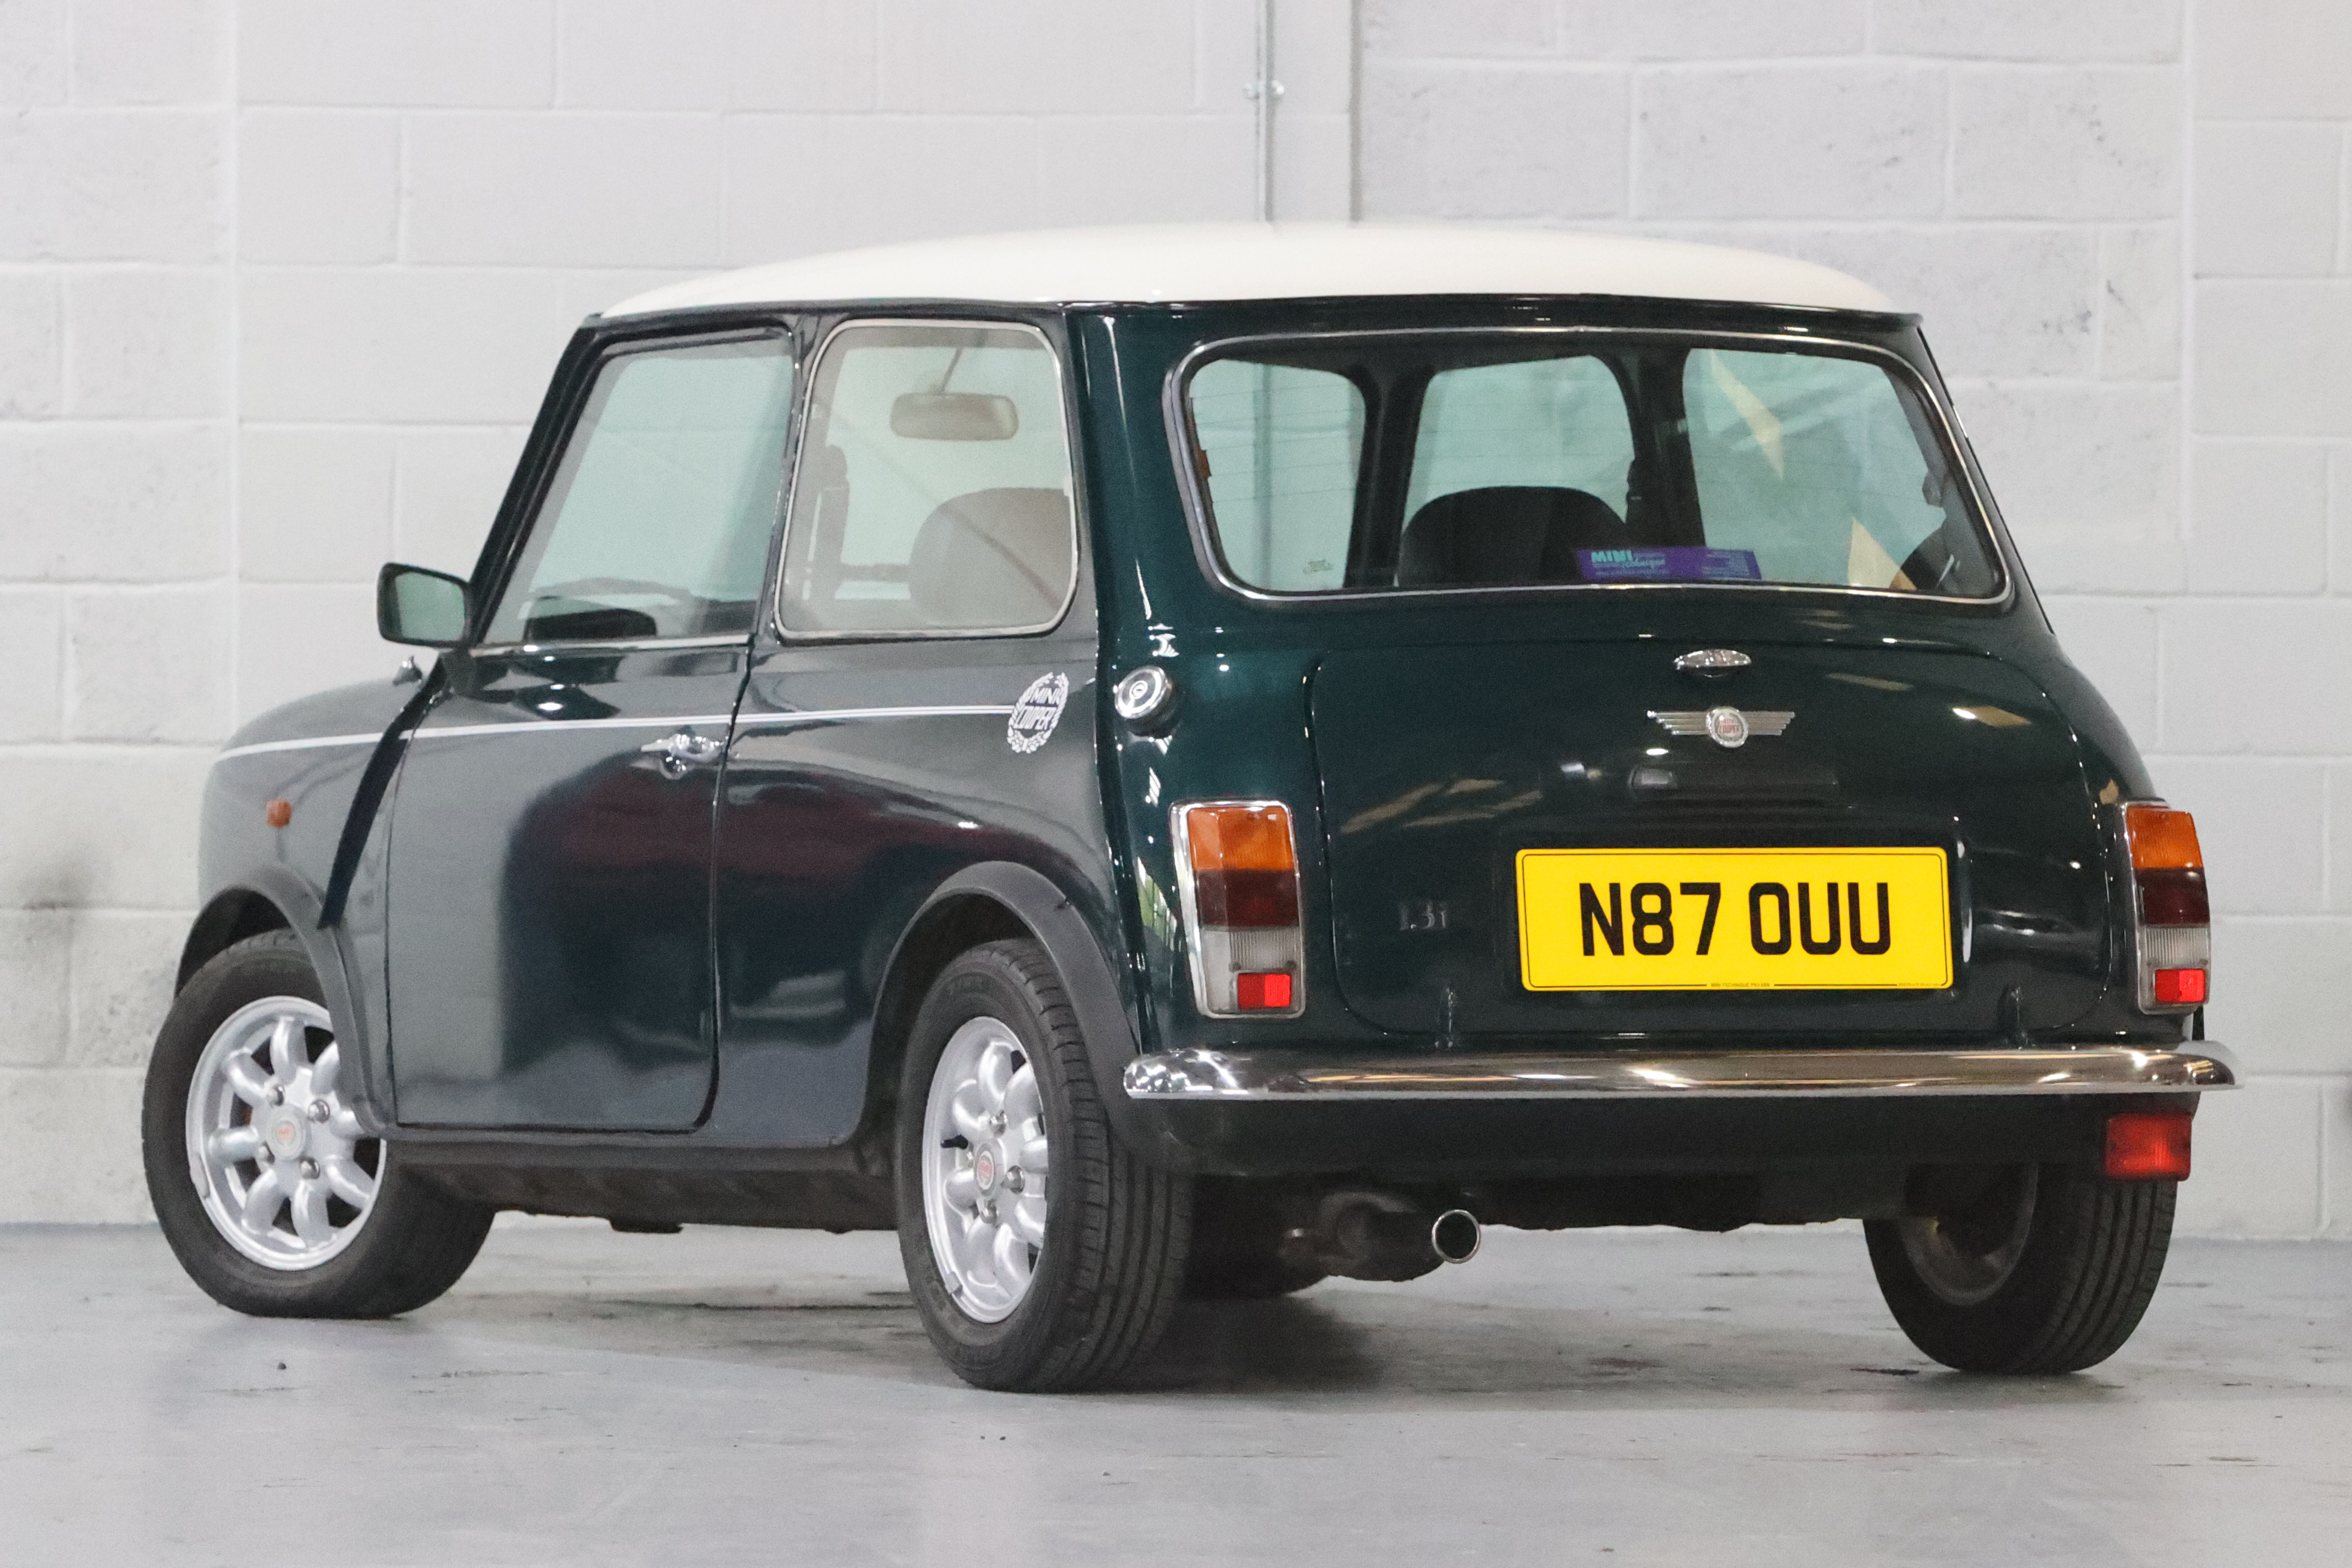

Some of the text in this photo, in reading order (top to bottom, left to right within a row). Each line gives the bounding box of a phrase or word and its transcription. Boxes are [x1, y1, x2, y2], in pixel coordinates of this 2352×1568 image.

[1591, 550, 1633, 563] MINI
[1013, 705, 1057, 730] COOPER
[1579, 882, 1891, 956] N87 OUU
